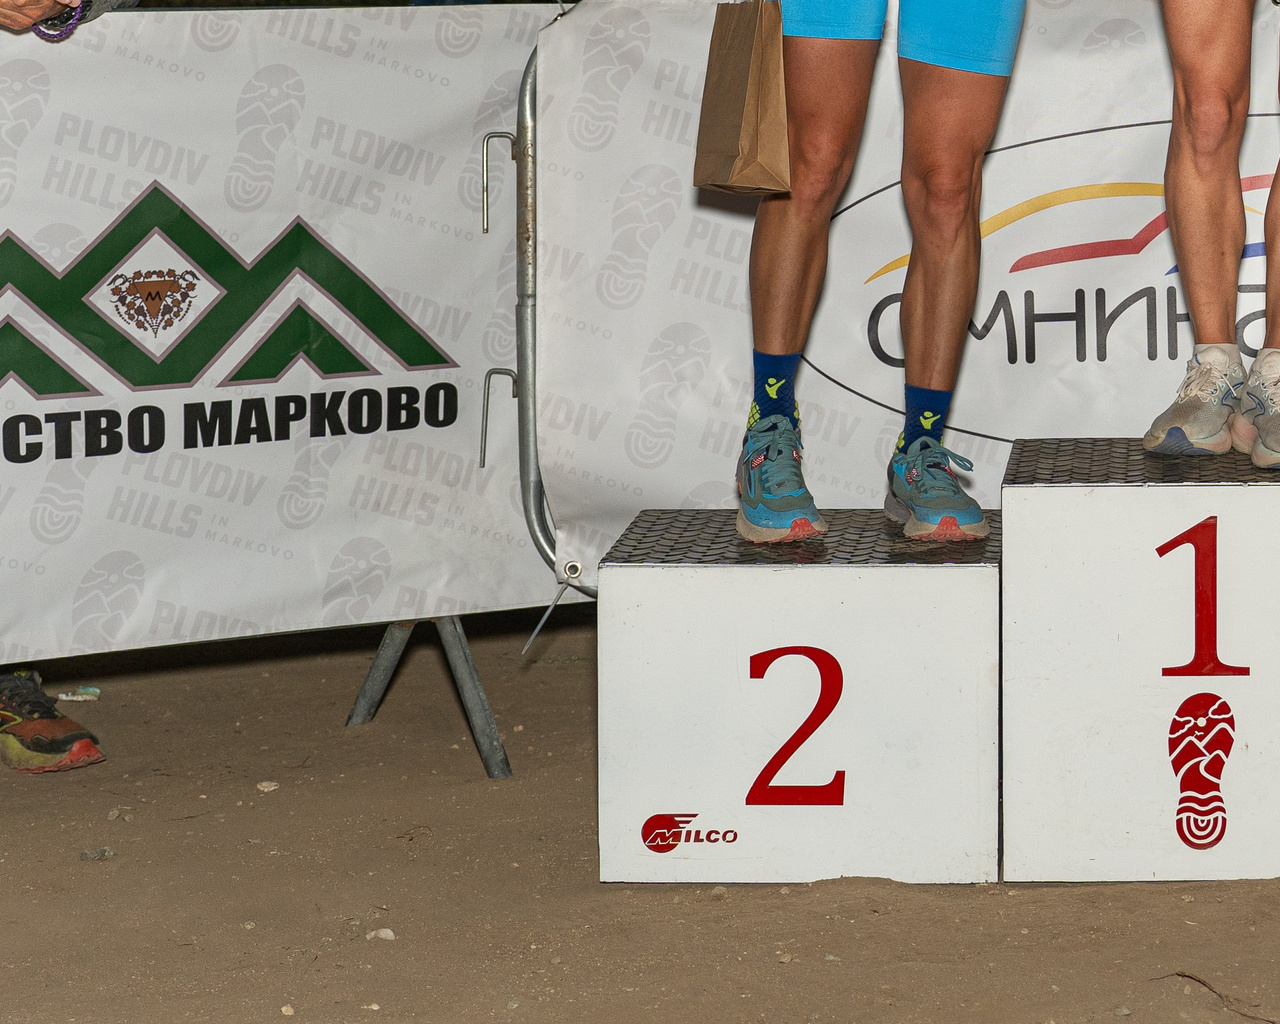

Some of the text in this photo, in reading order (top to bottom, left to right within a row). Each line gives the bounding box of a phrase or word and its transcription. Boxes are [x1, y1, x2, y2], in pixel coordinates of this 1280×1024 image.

[265, 10, 361, 58] HILLS
[369, 37, 388, 50] IN
[114, 45, 206, 82] MARKOVO
[363, 51, 450, 87] MARKOVO
[54, 111, 209, 185] PLOVDIV
[310, 116, 448, 187] PLOVDIV
[295, 159, 387, 215] HILLS
[393, 191, 412, 205] IN
[390, 206, 474, 242] MARKOVO
[1, 381, 459, 463] СТВО МАРКОВО
[121, 450, 269, 508] PLOVDIV
[363, 434, 498, 495] PLOVDIV
[552, 461, 643, 496] MARKOVO
[105, 485, 202, 539] HILLS
[210, 512, 229, 527] IN
[347, 475, 440, 526] HILLS
[447, 501, 466, 516] IN
[205, 530, 295, 561] MARKOVO
[443, 517, 528, 550] MARKOVO
[1155, 516, 1250, 676] 1
[746, 646, 845, 806] 2
[645, 829, 738, 845] MILCO
